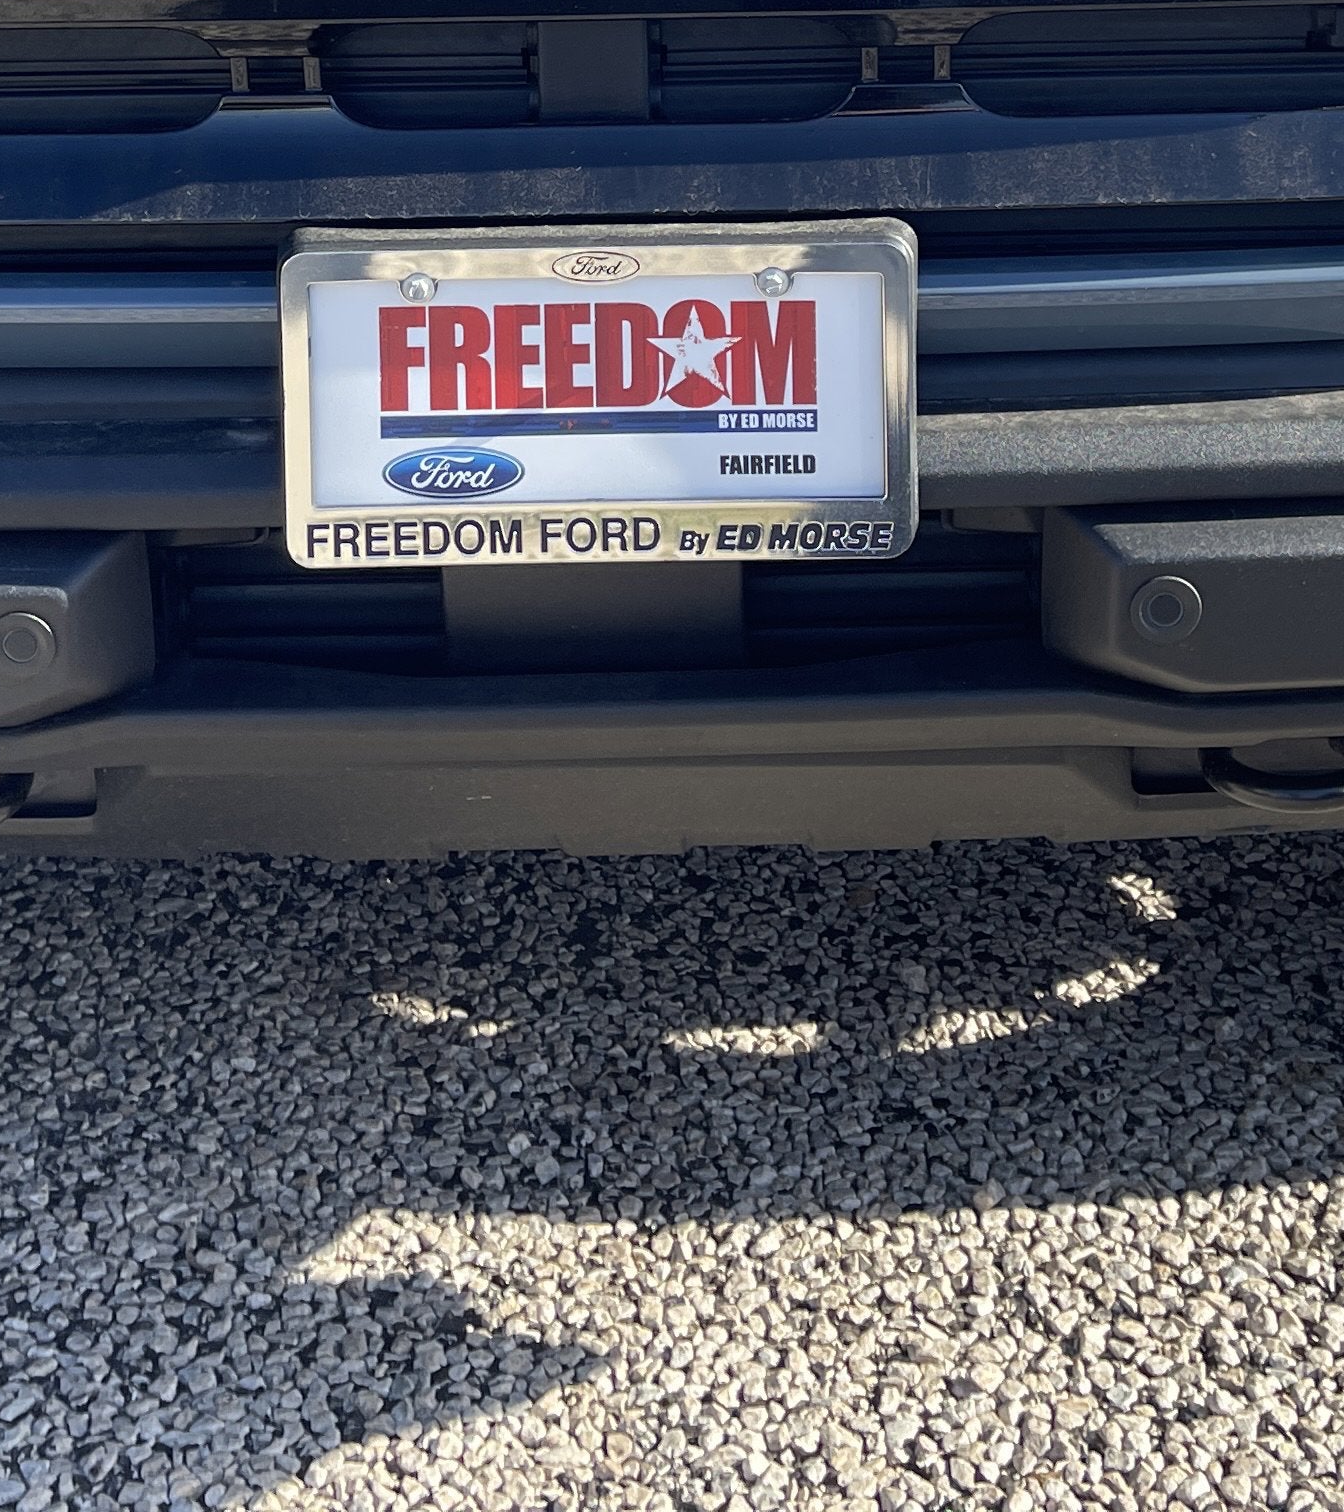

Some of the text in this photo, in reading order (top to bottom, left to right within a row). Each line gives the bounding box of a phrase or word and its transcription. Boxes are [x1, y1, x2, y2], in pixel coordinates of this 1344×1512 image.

[571, 255, 623, 276] Ford
[378, 298, 817, 412] FREEDOM
[718, 412, 815, 429] BY ED MORSE
[411, 454, 817, 489] Ford FAIRFIELD
[306, 516, 894, 558] FREEDOM FORD By ED MORSE
